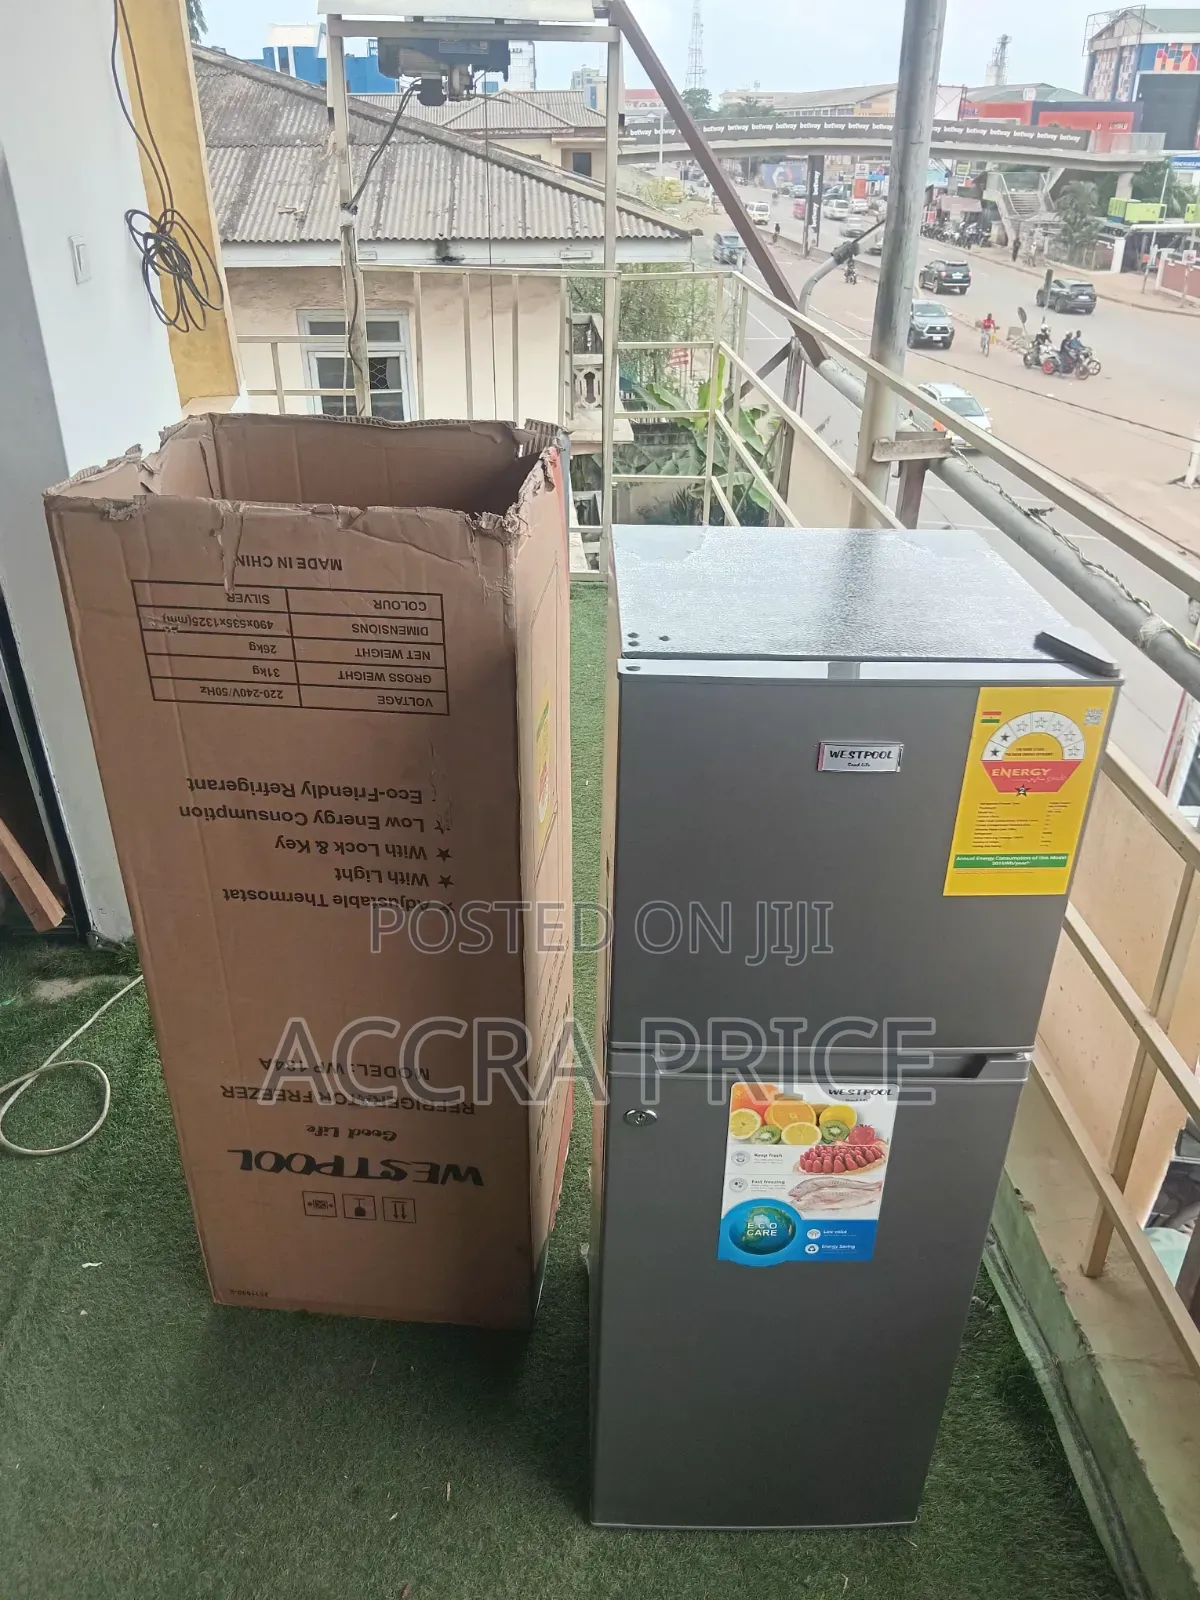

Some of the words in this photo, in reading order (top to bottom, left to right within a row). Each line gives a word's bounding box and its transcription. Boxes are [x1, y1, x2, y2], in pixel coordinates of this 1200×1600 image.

[630, 128, 652, 136] betway
[776, 122, 797, 130] betway
[848, 122, 870, 130] betway
[872, 123, 894, 131] betway
[944, 126, 964, 134] betway
[966, 128, 988, 136] betway
[990, 129, 1010, 137] betway
[1013, 131, 1034, 139] betway
[1037, 132, 1058, 140] betway
[1060, 134, 1080, 142] betway
[811, 203, 819, 228] betway
[278, 557, 292, 570] IN
[297, 557, 342, 572] MADE
[226, 592, 270, 605] SILVER
[373, 599, 428, 612] COLOUR
[162, 614, 274, 630] 490x535x1325(mm)
[352, 622, 430, 637] DIMENSIONS
[249, 641, 278, 654] 26kg
[355, 647, 404, 660] WEIGHT
[408, 649, 431, 661] NET
[252, 664, 281, 678] 31kg
[338, 670, 386, 682] WEIGHT
[388, 672, 432, 684] GROSS
[200, 685, 284, 700] 220-240V/50Hz
[378, 694, 434, 708] VOLTAGE
[829, 750, 894, 760] WESTPOOL
[992, 766, 1052, 778] ENERGY
[186, 777, 296, 798] Refrigerant
[300, 780, 423, 804] Eco-Friendly
[179, 804, 308, 826] Consumption
[313, 810, 380, 830] Energy
[385, 816, 425, 832] Low
[274, 834, 311, 854] Key
[314, 841, 328, 854] &
[334, 841, 380, 858] Lock
[384, 844, 428, 860] With
[334, 867, 382, 884] Light
[388, 870, 430, 888] With
[223, 888, 329, 908] Thermostat
[332, 894, 430, 913] Adjustable
[351, 1063, 430, 1080] MODEL:
[220, 1085, 312, 1104] FREEZER
[320, 1091, 475, 1115] REFRIGERATOR
[306, 1124, 340, 1138] Life
[348, 1128, 397, 1142] Good
[227, 1149, 484, 1186] WESTPOOL
